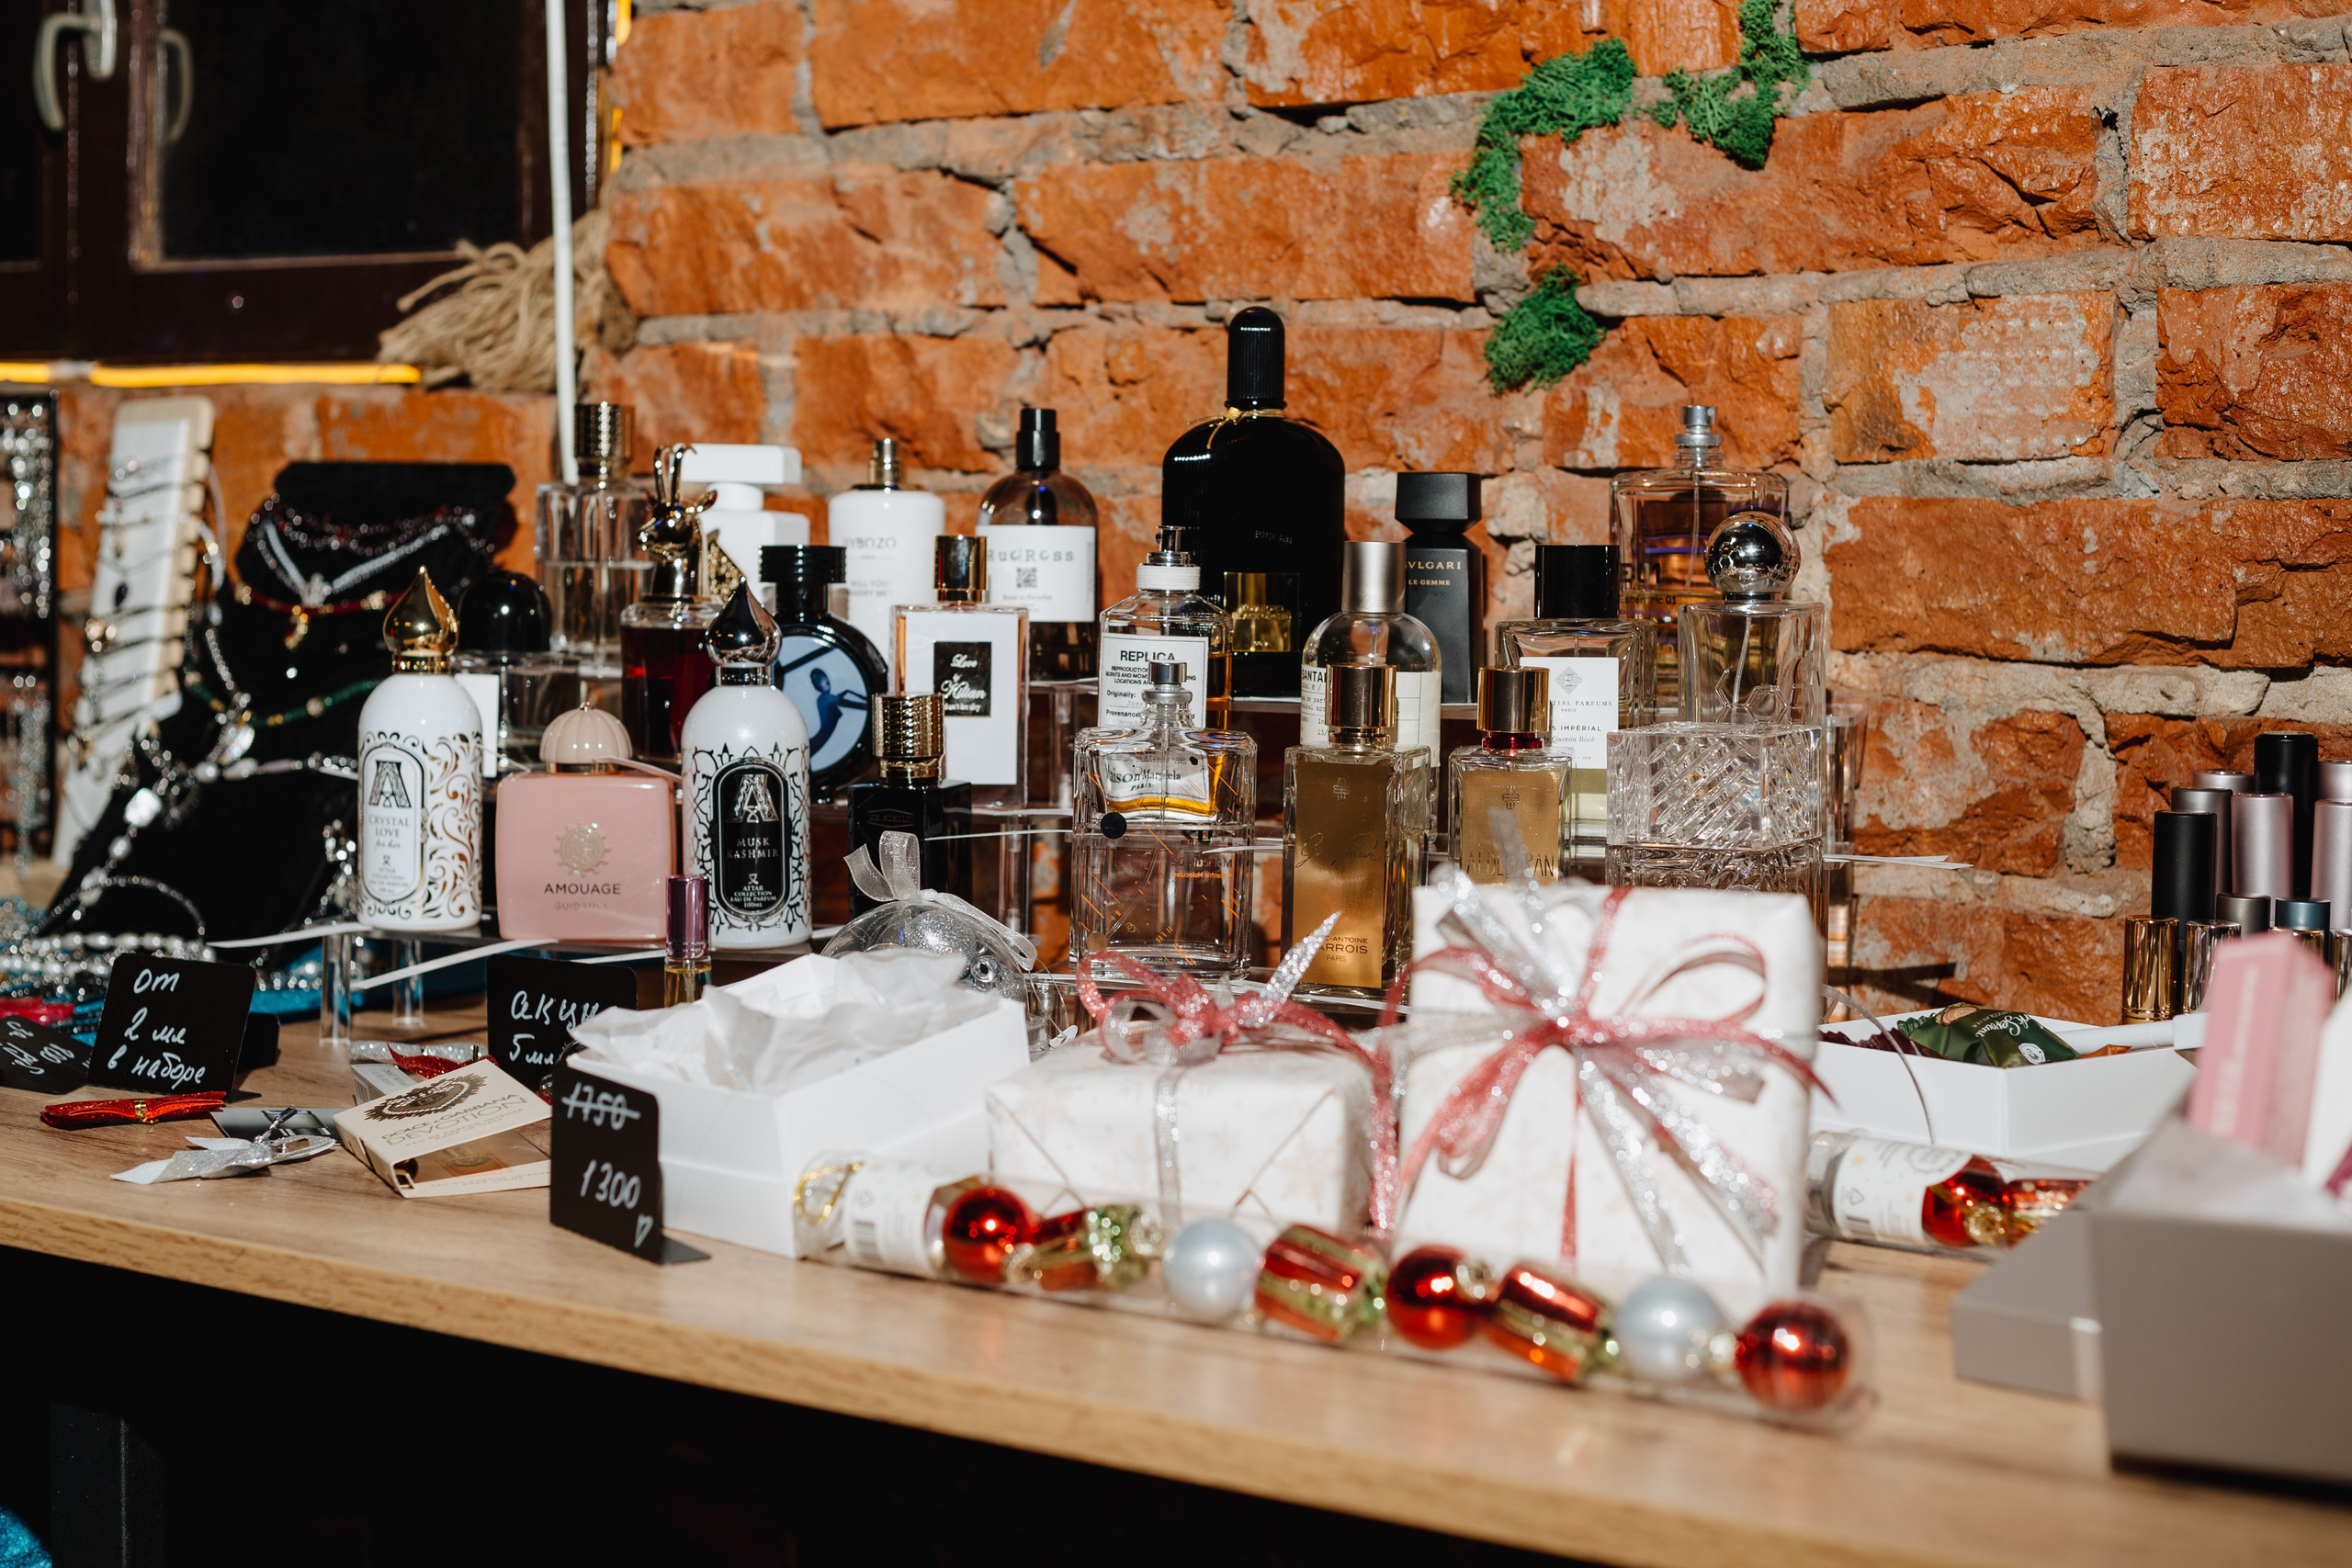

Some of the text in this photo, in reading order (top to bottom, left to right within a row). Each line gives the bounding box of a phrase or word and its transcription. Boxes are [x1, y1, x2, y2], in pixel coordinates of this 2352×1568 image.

[1406, 560, 1461, 570] VLGARI
[1665, 595, 1678, 604] 01
[1120, 649, 1175, 661] REPLICA
[950, 653, 978, 669] Love
[1106, 690, 1136, 698] Originally:
[1551, 734, 1577, 744] Quentin
[1578, 735, 1596, 743] Bisch
[368, 814, 410, 827] CRYSTAL
[375, 827, 401, 837] LOVE
[737, 837, 770, 847] MUSK
[727, 849, 779, 859] KASHMIR
[544, 883, 621, 895] AMOUAGE
[1323, 935, 1368, 944] C-ANTOINE
[1318, 942, 1368, 954] ARROIS
[1326, 954, 1347, 963] PARIS
[131, 1052, 206, 1089] наборе
[440, 1094, 519, 1121] GABBANA
[386, 1097, 526, 1145] DEVOTION
[581, 1160, 641, 1209] 1300
